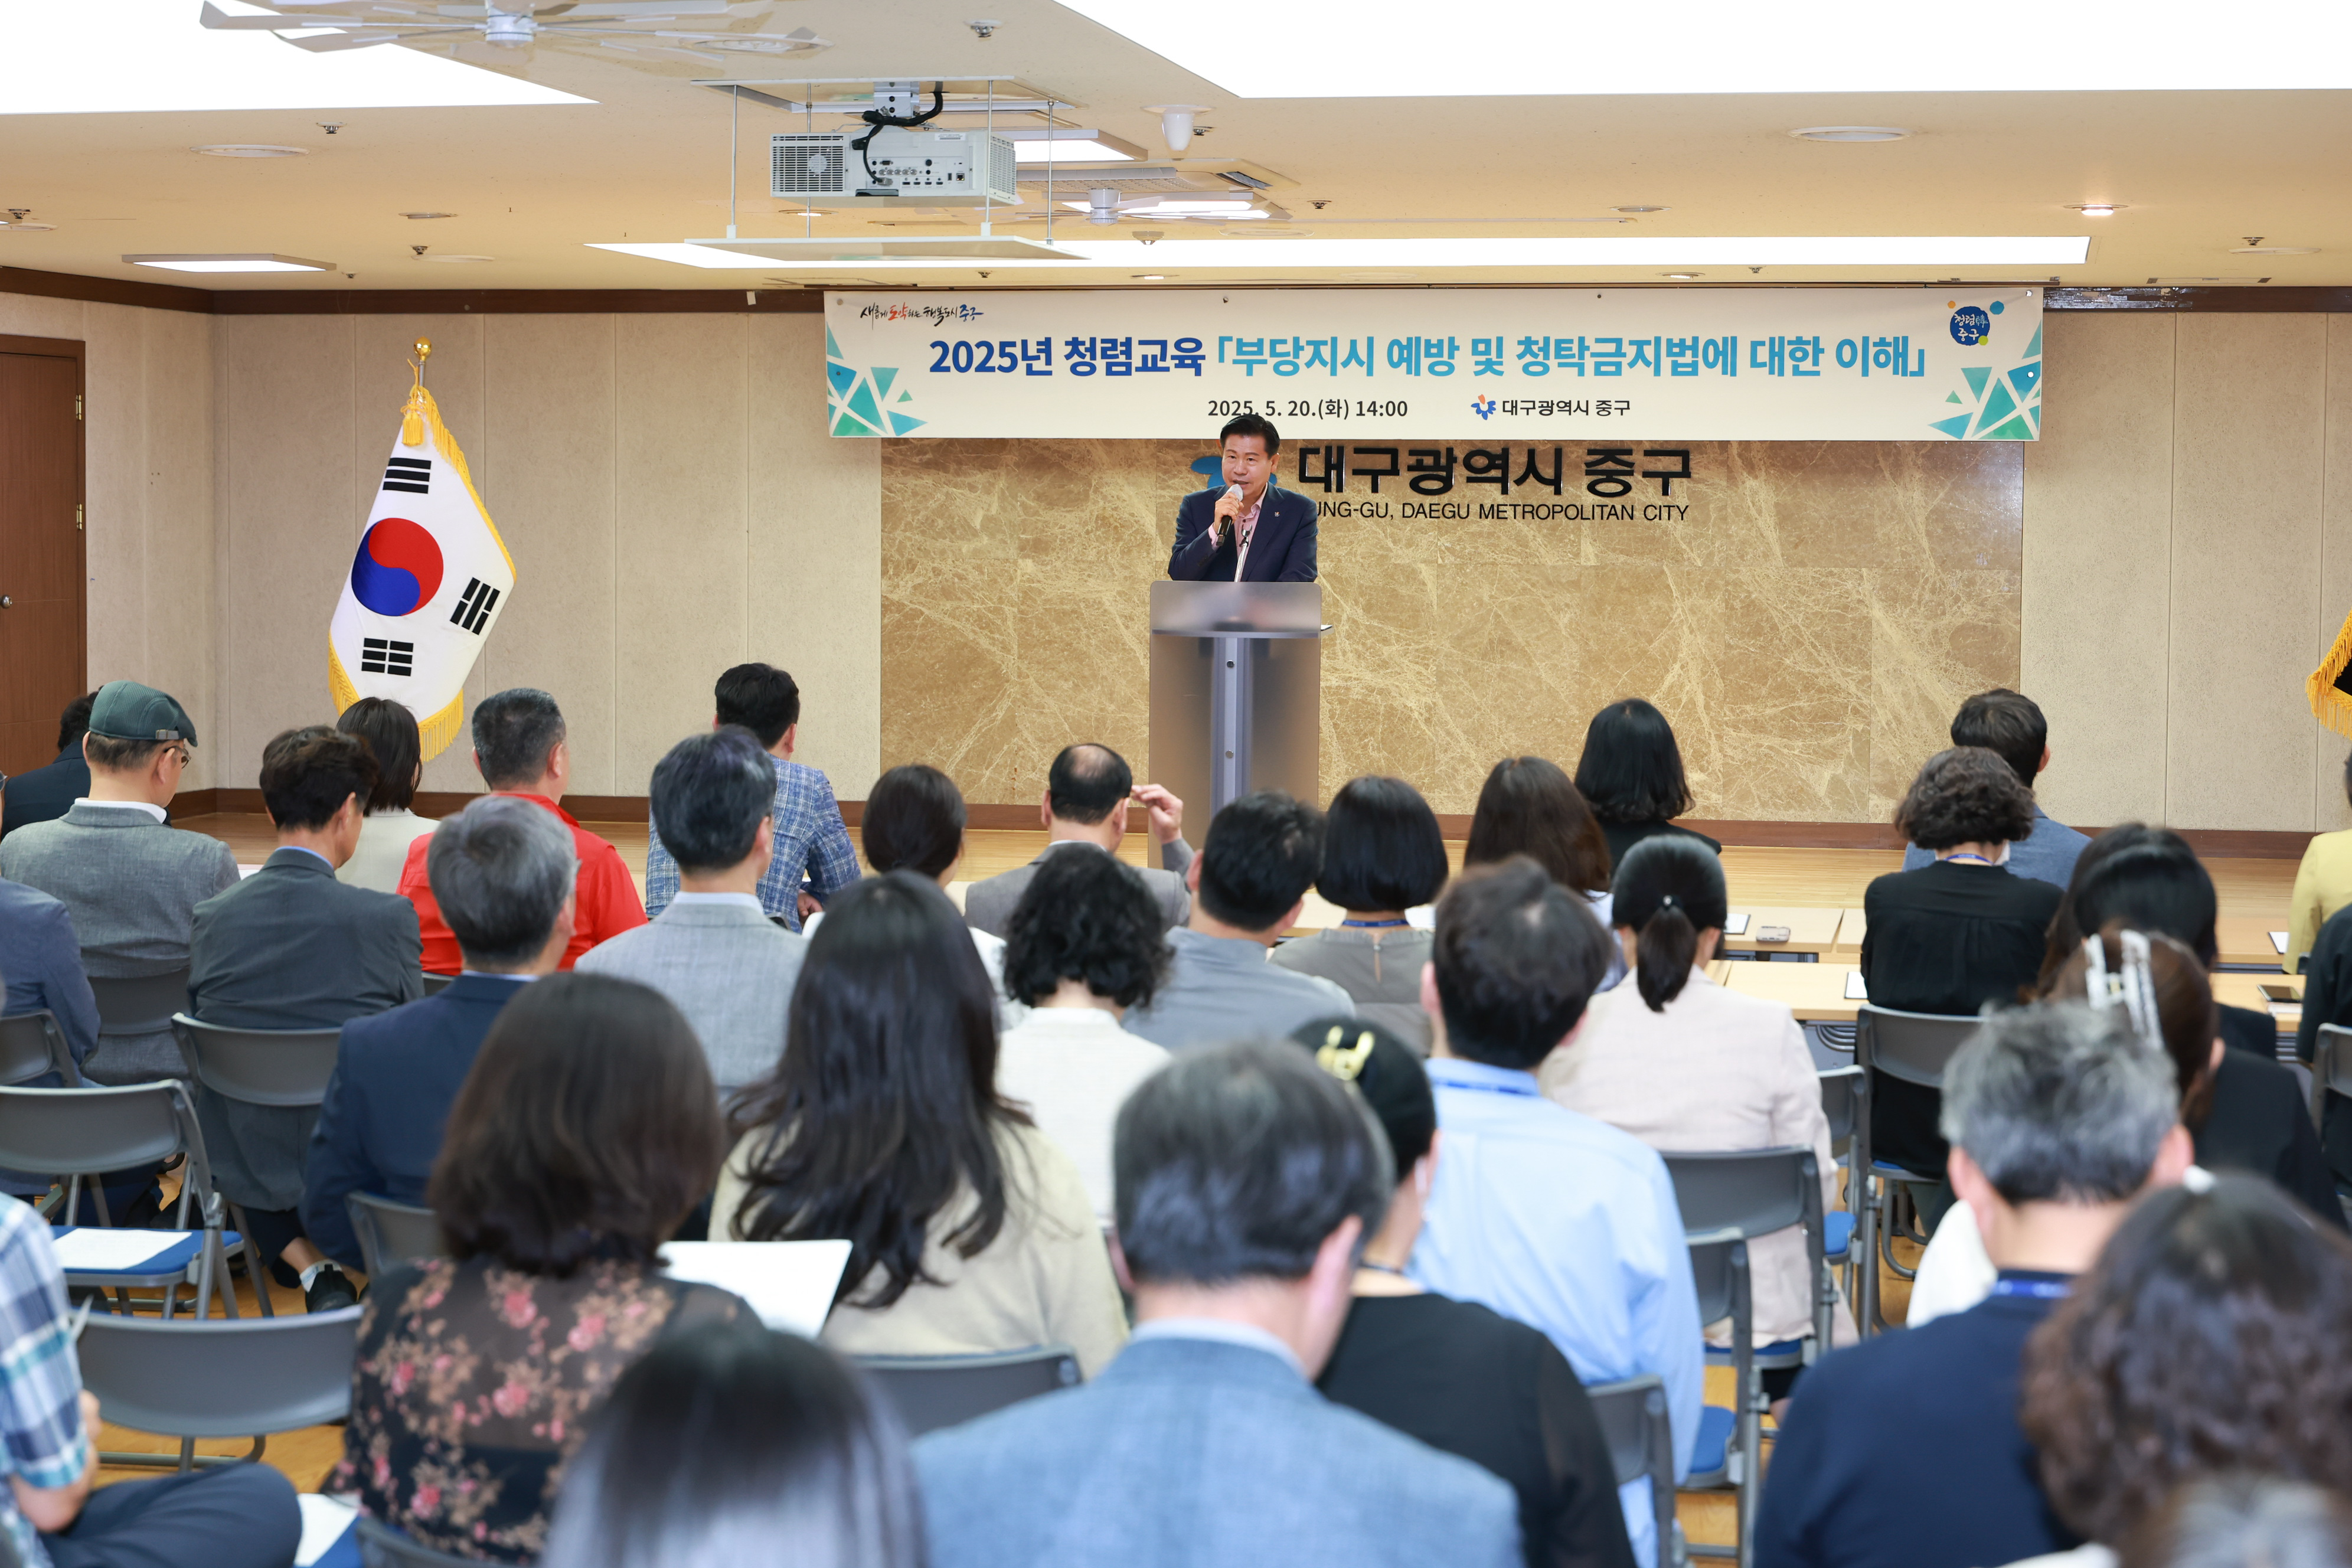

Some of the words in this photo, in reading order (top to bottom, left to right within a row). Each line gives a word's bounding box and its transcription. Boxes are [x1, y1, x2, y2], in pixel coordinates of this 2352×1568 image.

[888, 302, 923, 321] 도약하는
[923, 305, 958, 326] 행복도시
[959, 304, 984, 322] 중구
[1958, 328, 1979, 341] 중구
[930, 337, 1053, 376] 2025년
[1064, 337, 1206, 377] 청렴교육
[1387, 336, 1460, 377] 예방
[1472, 336, 1505, 377] 및
[1515, 335, 1737, 377] 청탁금지법에
[1750, 336, 1825, 377] 대한
[1208, 400, 1259, 416] 2025.
[1288, 399, 1349, 420] 20.(화)
[1356, 401, 1407, 417] 14:00
[1502, 400, 1589, 416] 대구광역시
[1596, 400, 1630, 416] 중구
[1299, 445, 1563, 496] 대구광역시
[1583, 447, 1692, 499] 중구
[1402, 502, 1470, 520] DAEGU
[1479, 503, 1634, 521] METROPOLITAN
[1643, 504, 1689, 521] CITY
